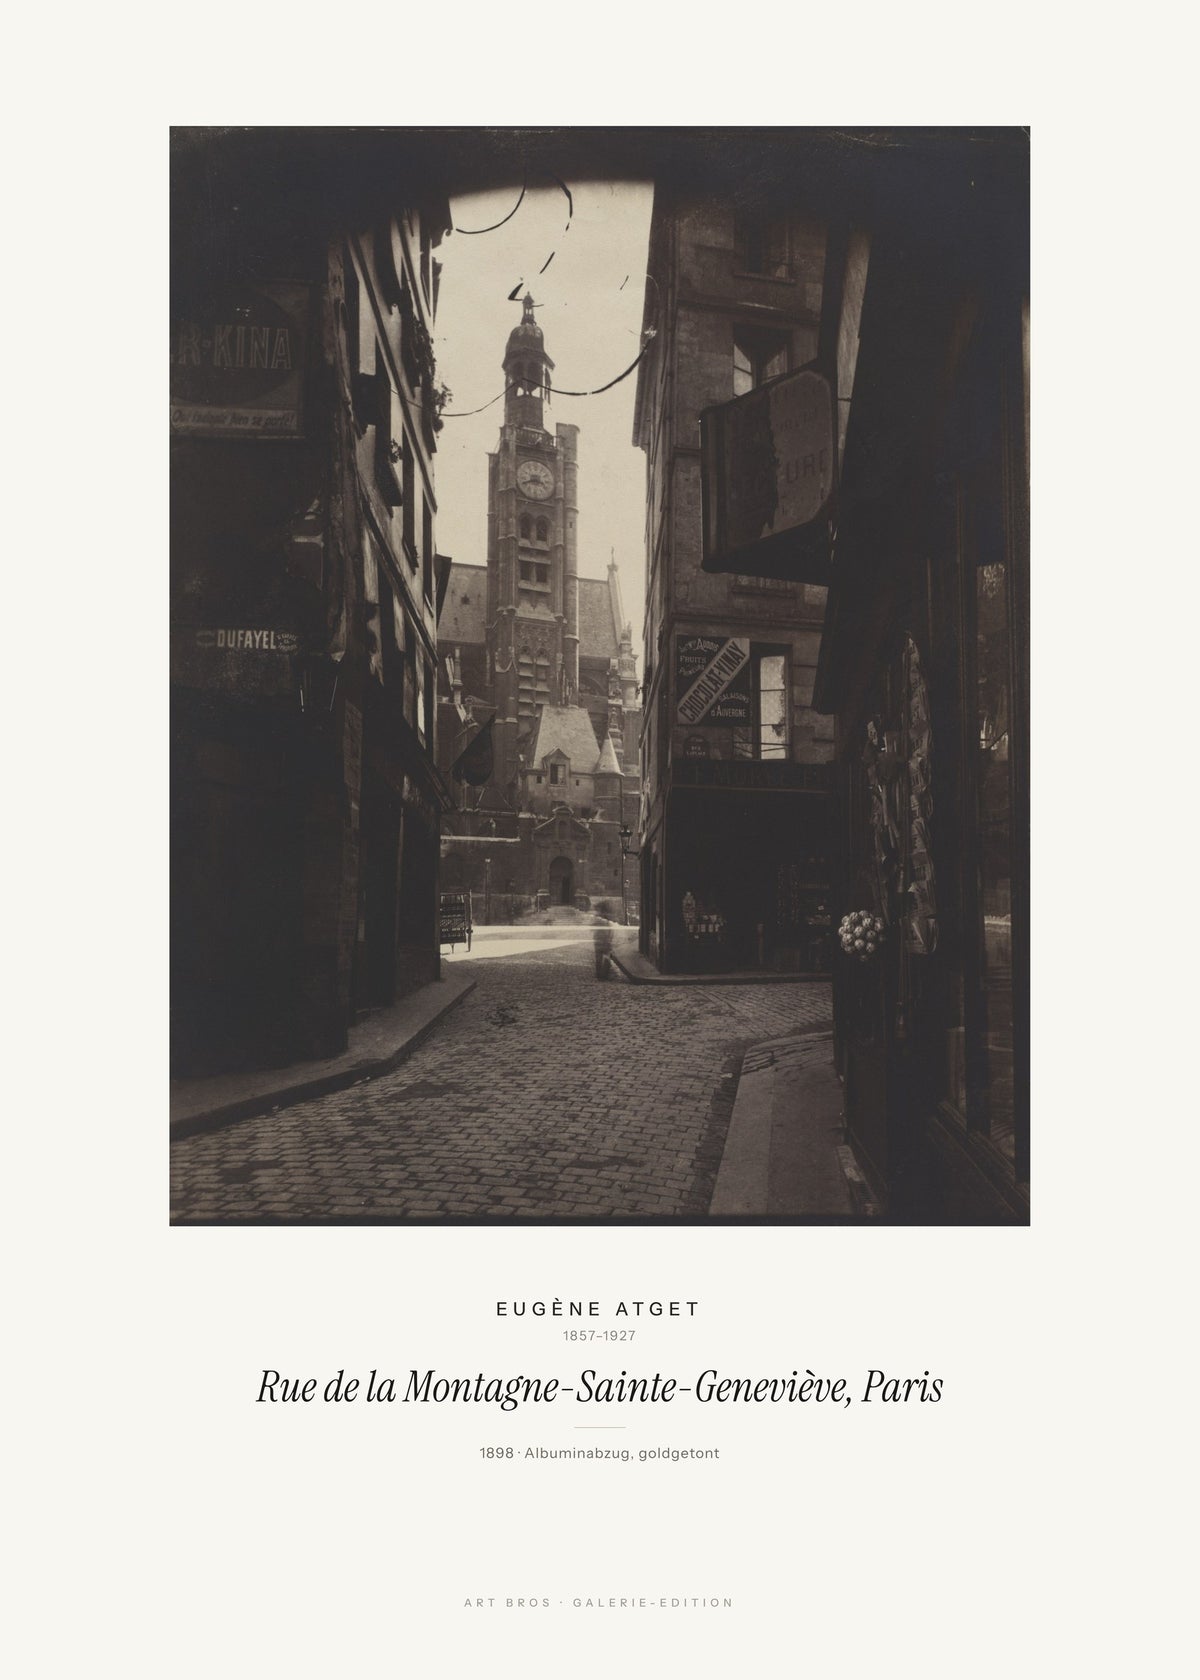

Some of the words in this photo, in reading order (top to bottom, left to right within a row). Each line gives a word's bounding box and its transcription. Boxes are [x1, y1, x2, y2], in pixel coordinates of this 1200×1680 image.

[171, 324, 292, 369] R-KINA
[217, 629, 277, 650] DUFAYEL
[679, 655, 707, 664] FRUITS
